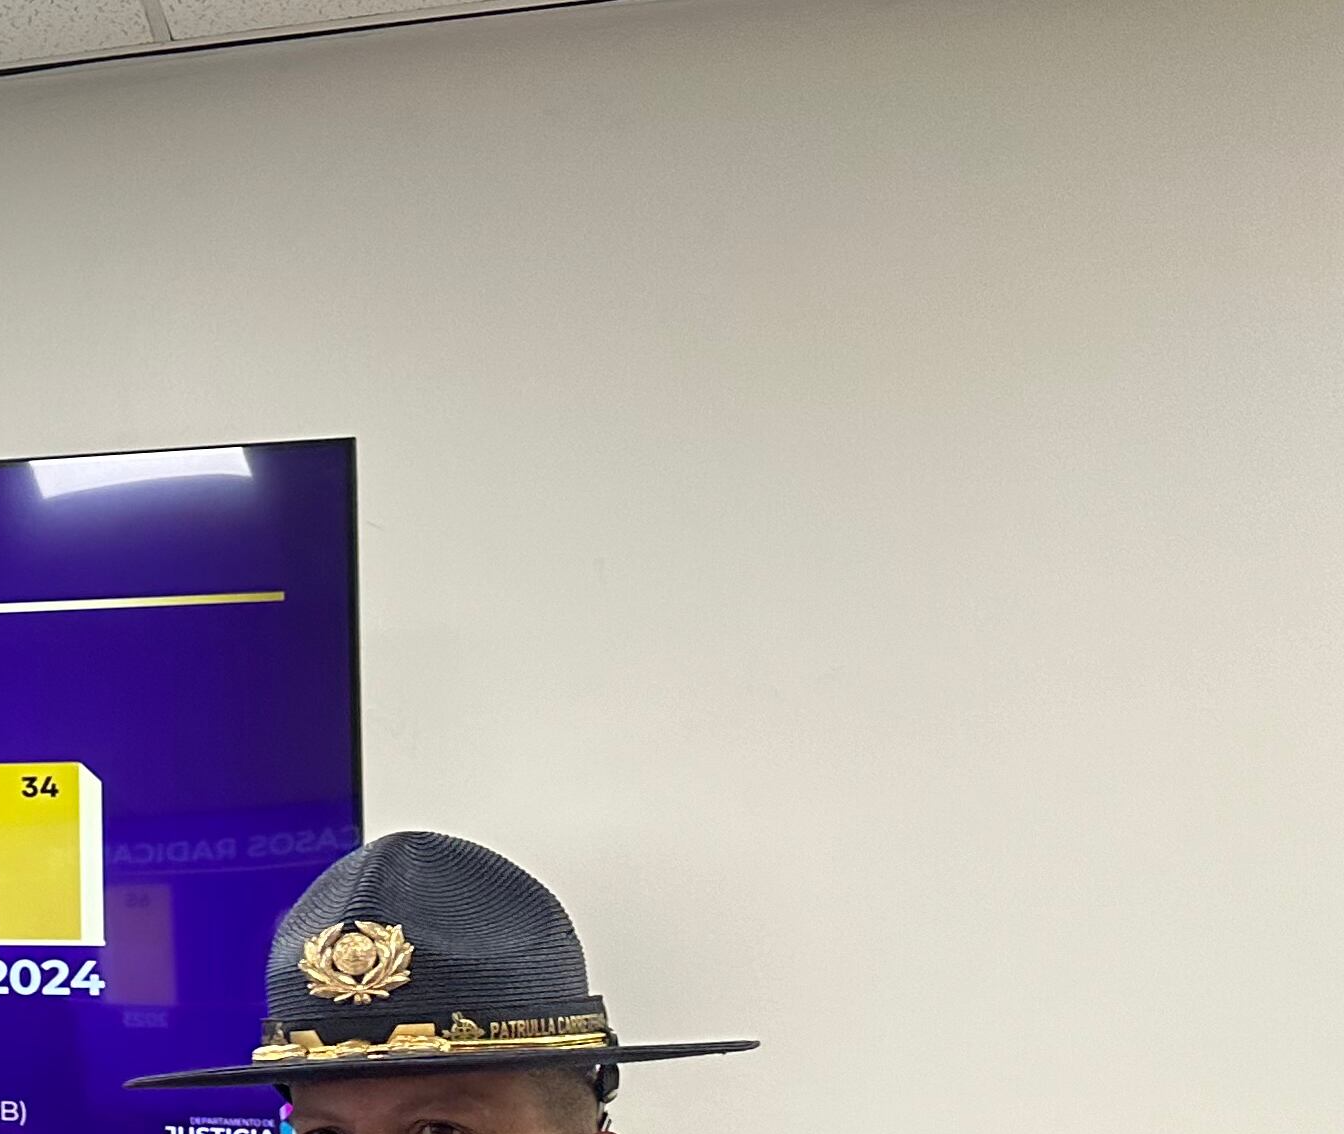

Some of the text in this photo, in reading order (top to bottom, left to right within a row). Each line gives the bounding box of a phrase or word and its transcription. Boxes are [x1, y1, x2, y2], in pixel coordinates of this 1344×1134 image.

[21, 775, 60, 798] 34
[489, 1017, 555, 1040] PATRULLA
[0, 1100, 27, 1126] B)
